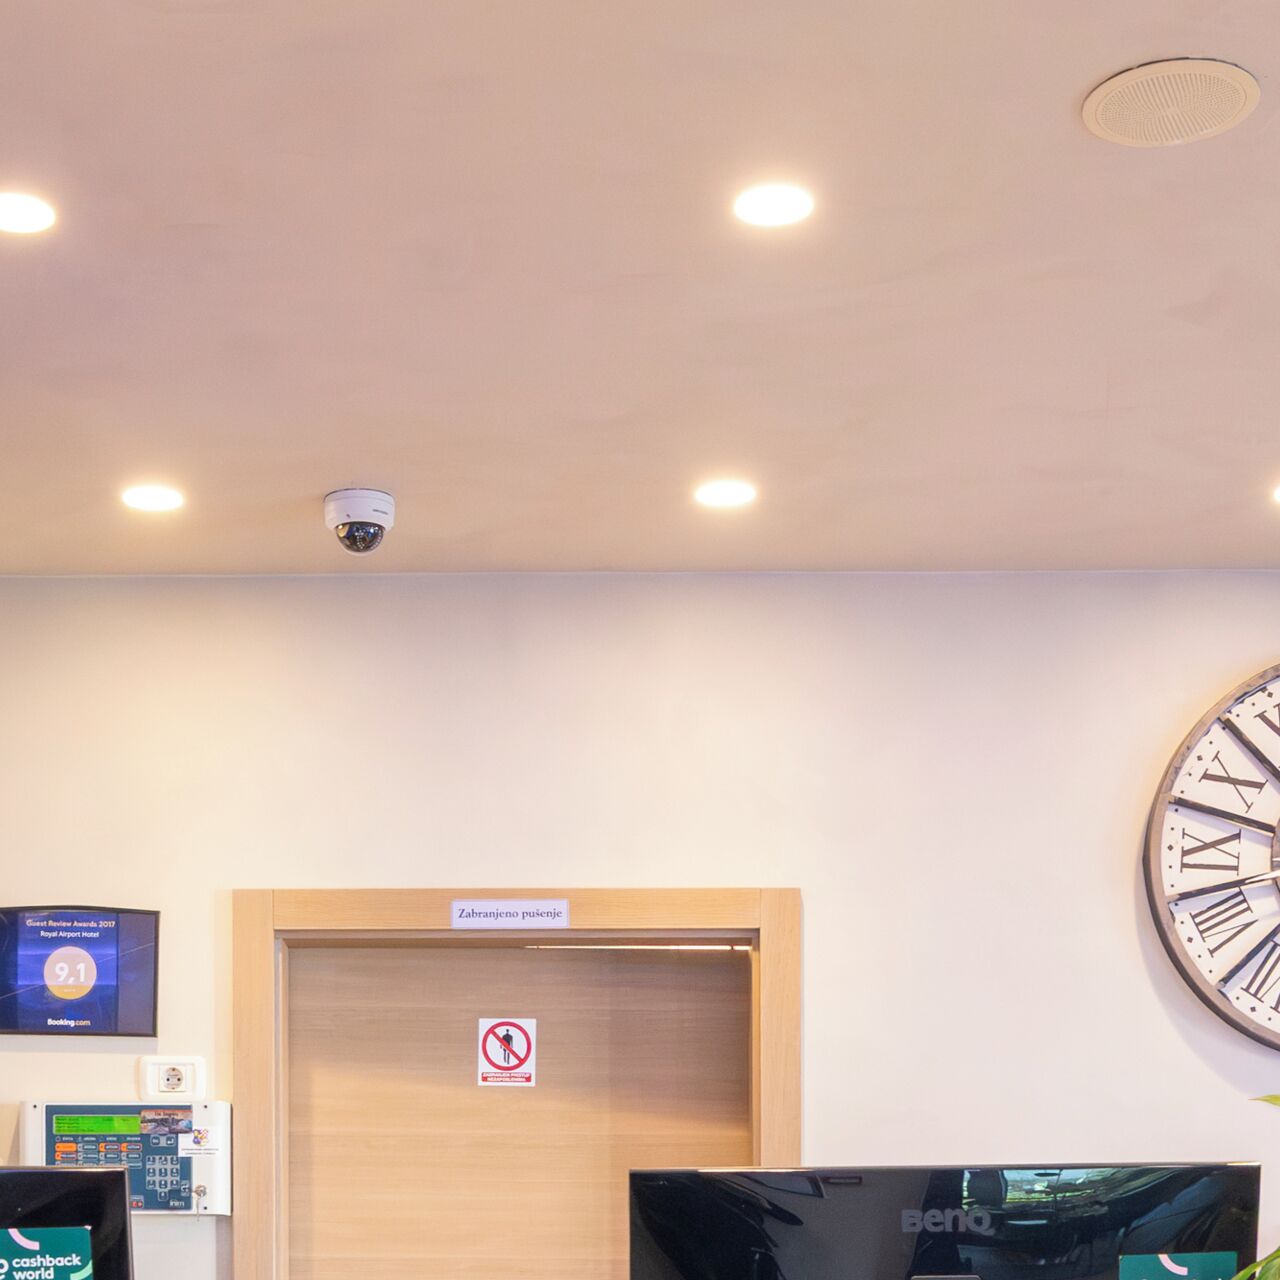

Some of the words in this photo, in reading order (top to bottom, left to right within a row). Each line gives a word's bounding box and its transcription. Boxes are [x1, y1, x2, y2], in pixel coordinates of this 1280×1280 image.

[1198, 750, 1268, 813] X
[1180, 827, 1242, 876] IX
[458, 908, 519, 920] Zabranjeno
[521, 908, 563, 920] pušenje
[25, 919, 48, 928] Guest
[48, 920, 72, 928] Review
[73, 920, 97, 928] Awards
[98, 920, 116, 928] 2017
[1189, 886, 1259, 958] VIII
[40, 930, 58, 938] Royal
[58, 930, 81, 939] Airport
[54, 962, 86, 984] 9,1
[47, 1018, 91, 1028] Booking.com
[901, 1208, 996, 1236] BenQ
[12, 1253, 82, 1268] cashback
[12, 1267, 54, 1280] world
